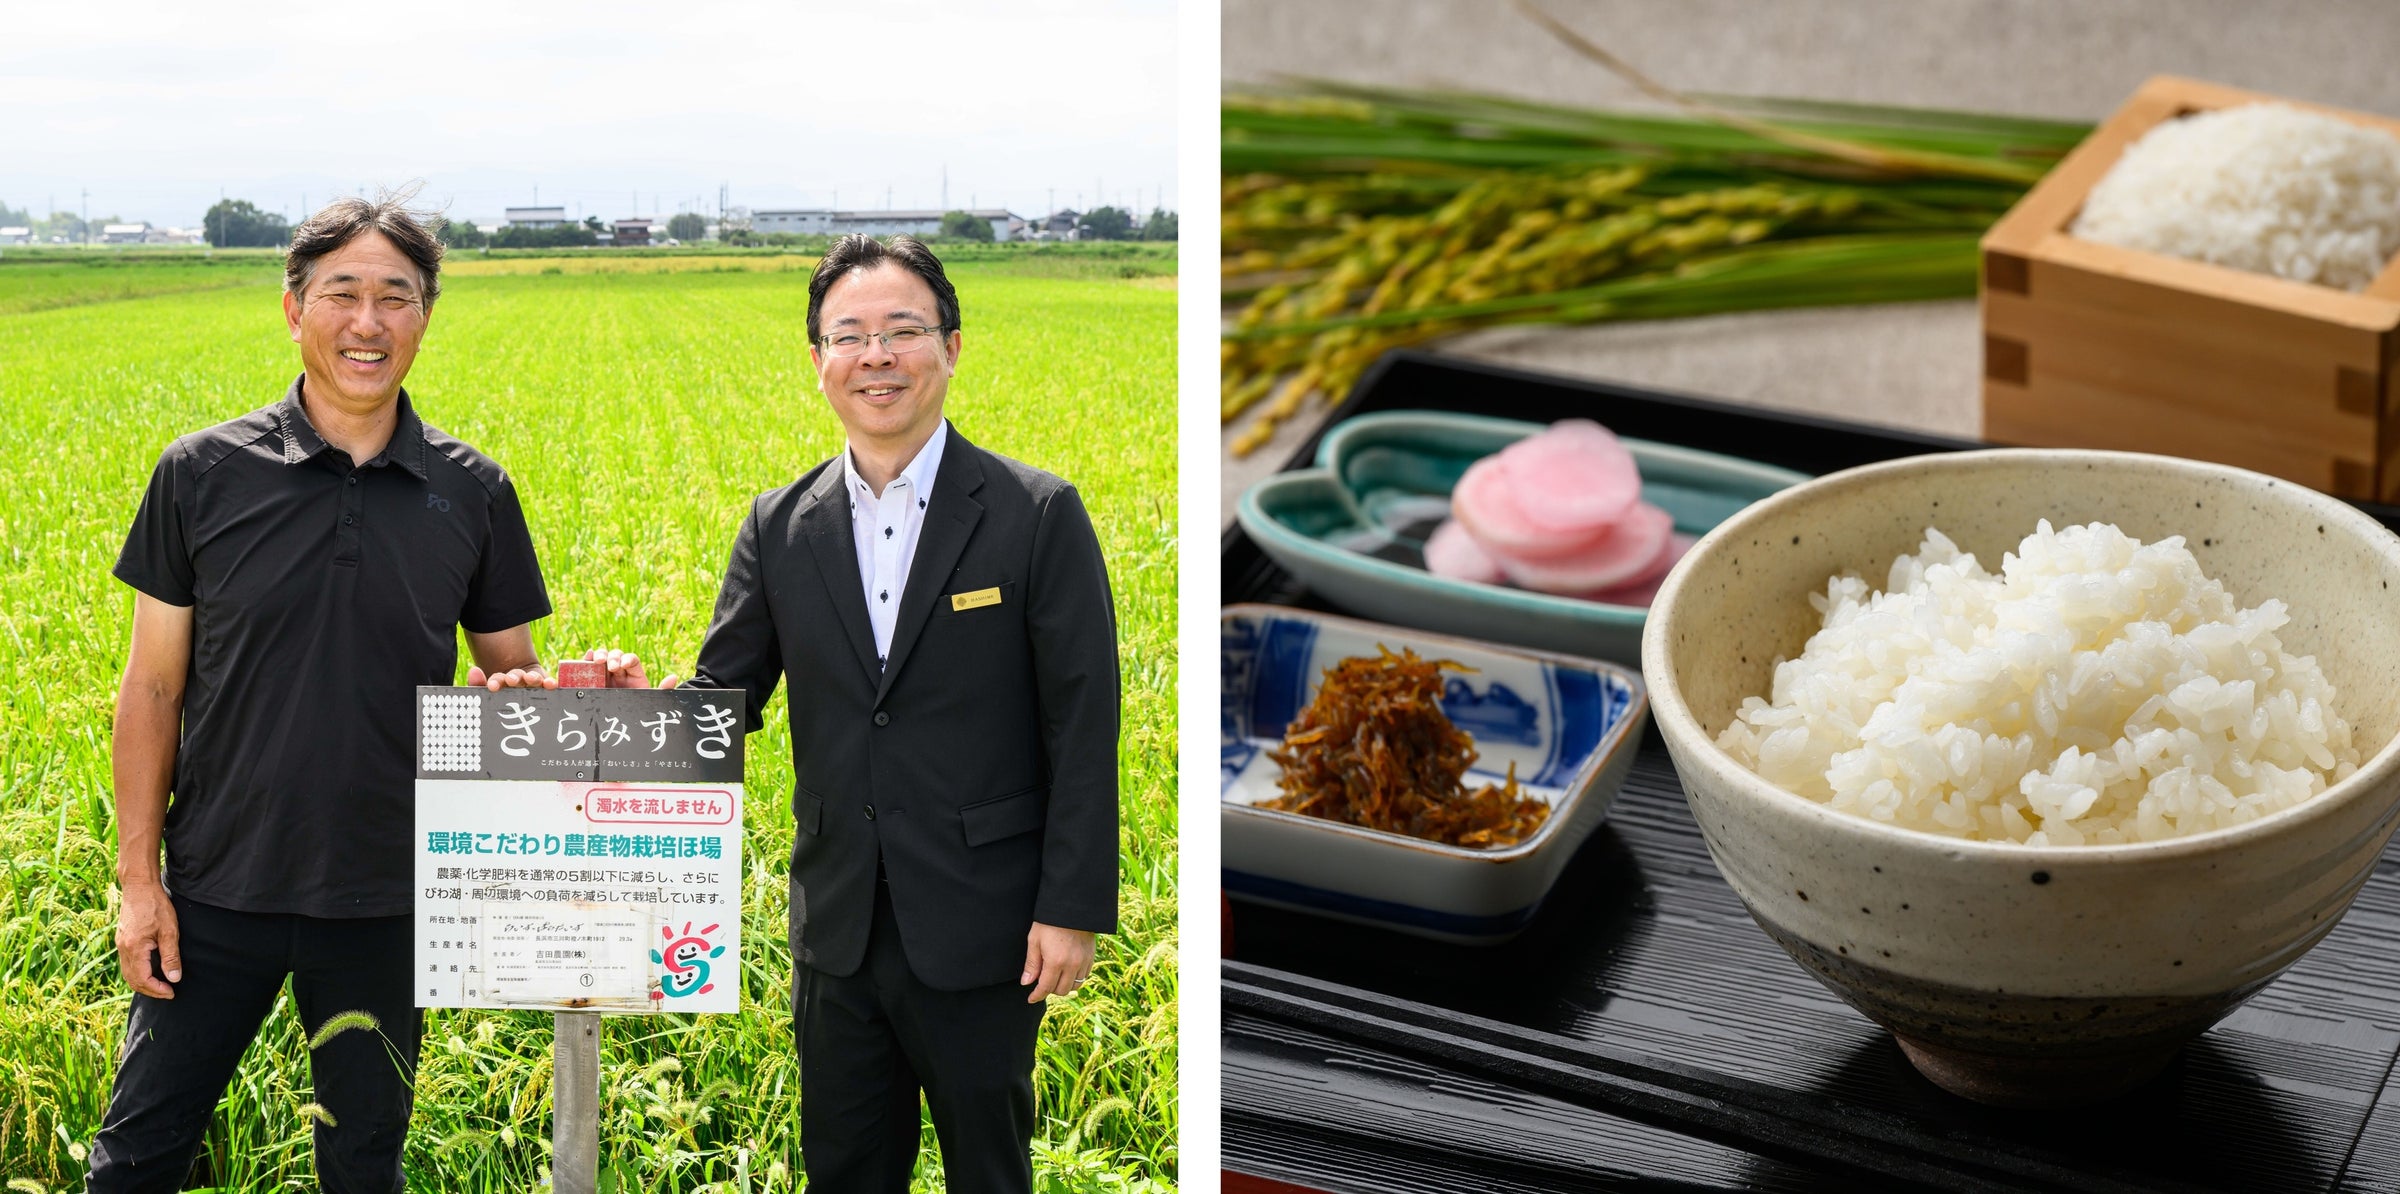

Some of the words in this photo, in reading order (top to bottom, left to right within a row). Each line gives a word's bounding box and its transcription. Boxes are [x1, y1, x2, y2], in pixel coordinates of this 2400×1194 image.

[497, 702, 737, 759] きらみずき
[596, 797, 723, 815] 濁水を流しません
[427, 831, 722, 860] 環境こだわり農産物栽培ほ場
[429, 940, 477, 950] 生産者名
